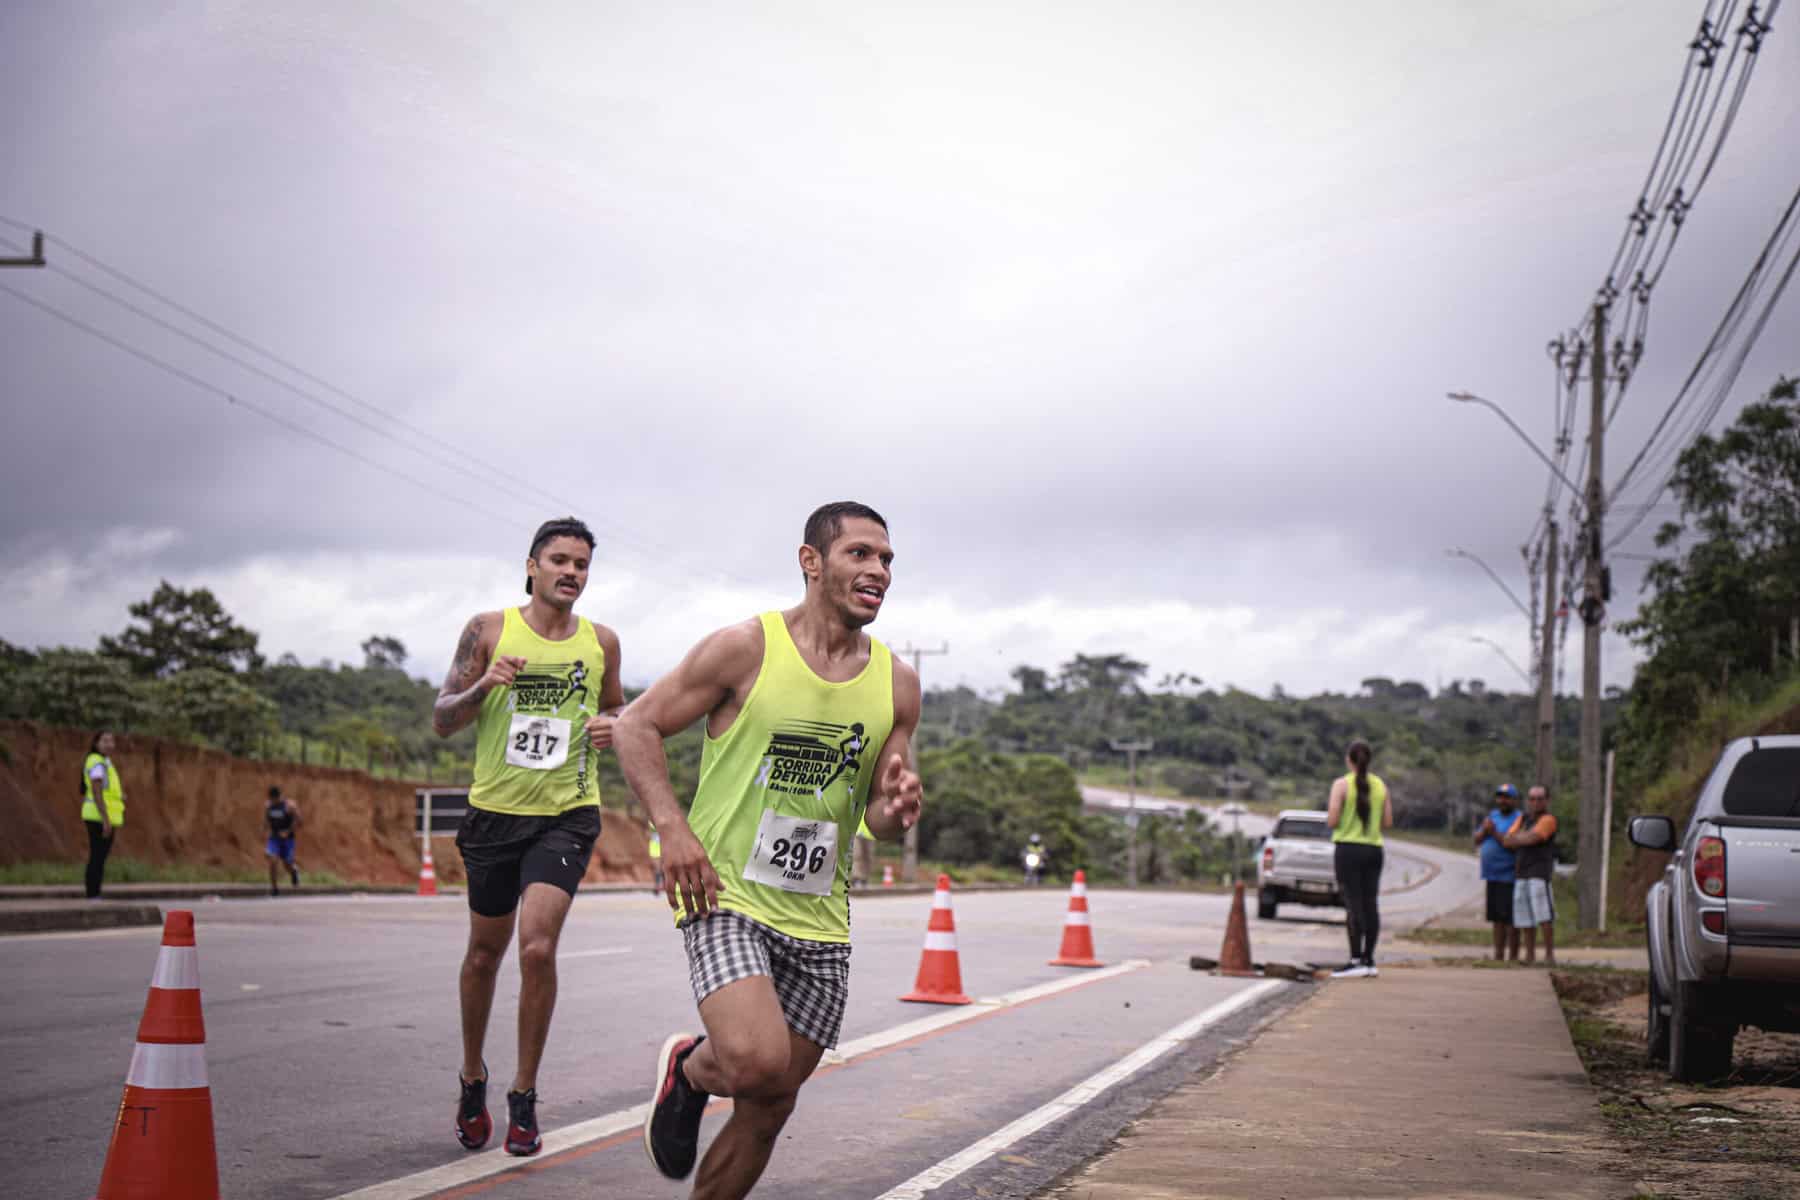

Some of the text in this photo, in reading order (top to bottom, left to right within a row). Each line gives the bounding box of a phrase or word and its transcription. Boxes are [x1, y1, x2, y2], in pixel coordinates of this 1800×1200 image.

[514, 731, 559, 756] 217
[774, 757, 832, 775] CORRIDA
[770, 768, 826, 787] DETRAN
[769, 838, 828, 874] 296
[782, 870, 806, 881] 10KM
